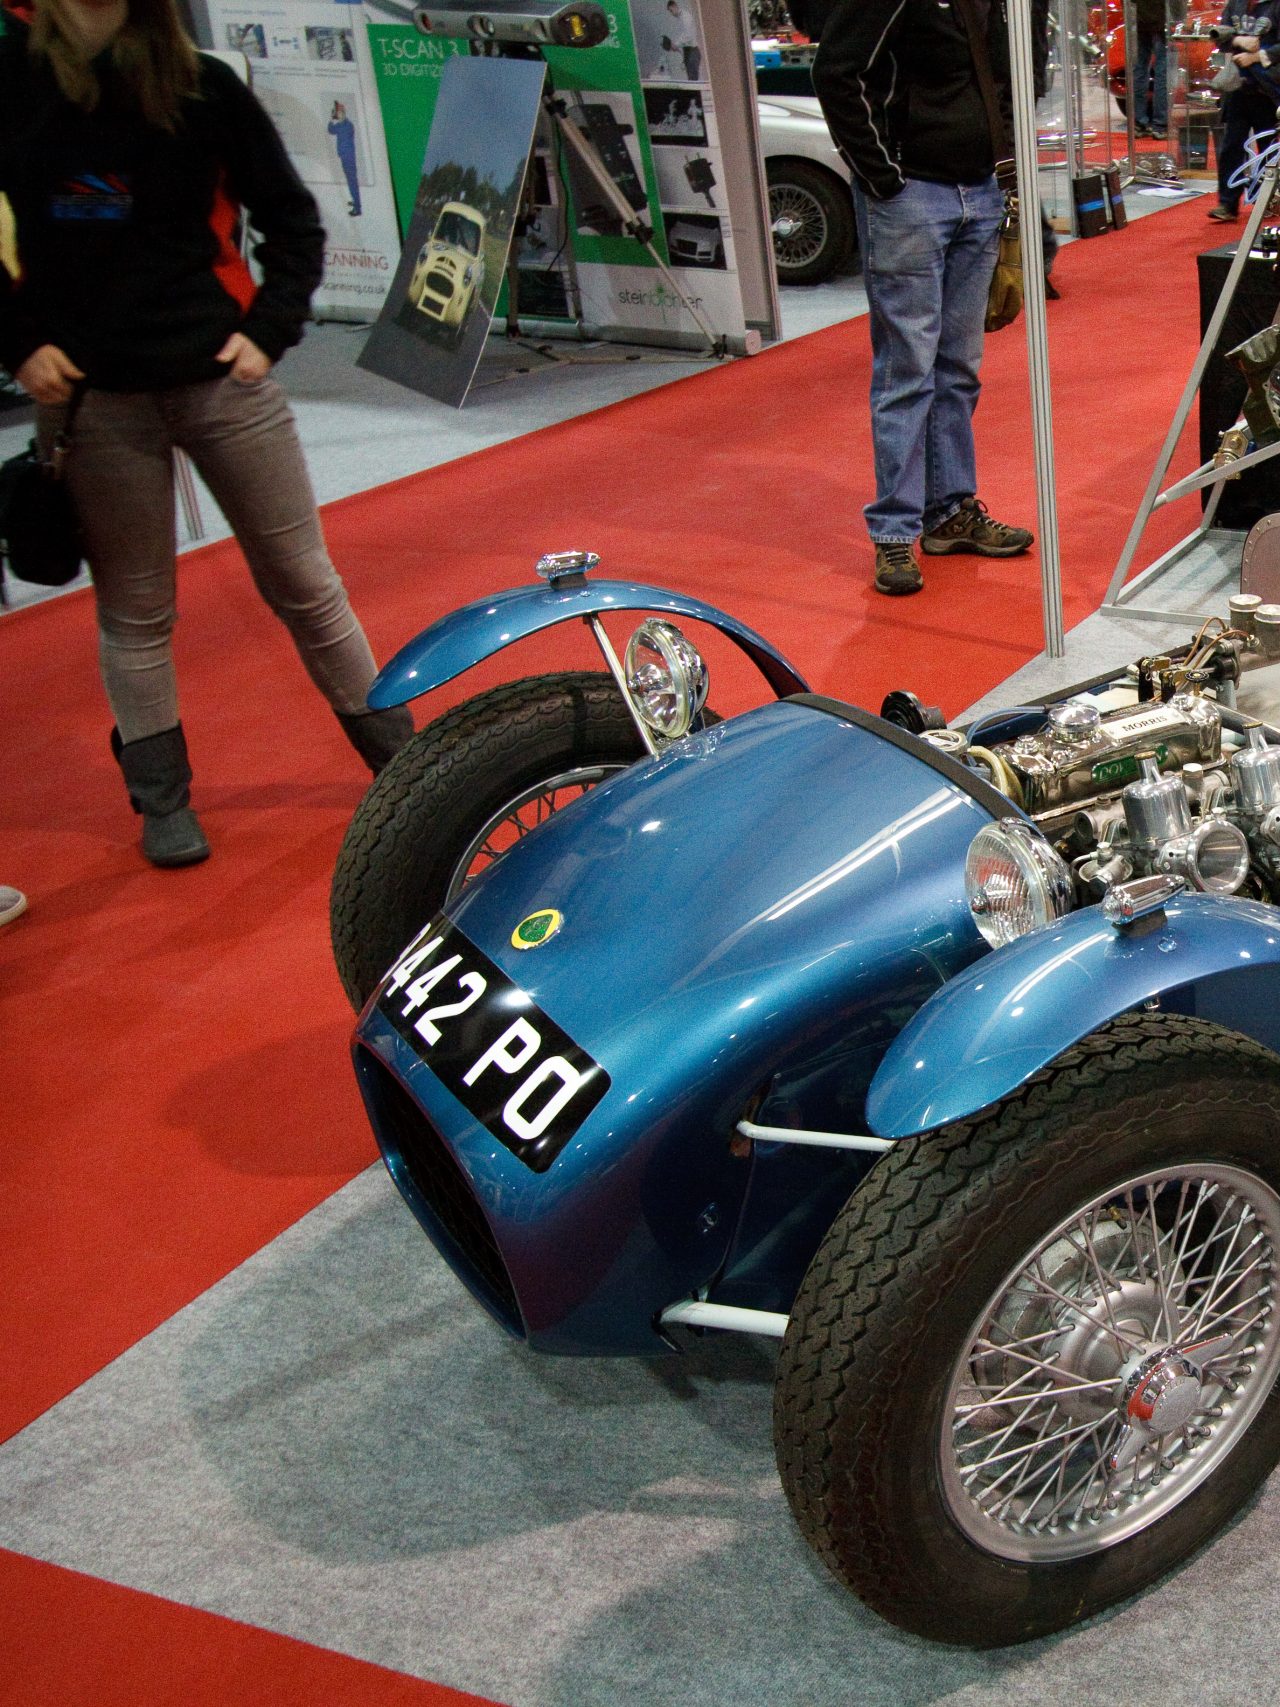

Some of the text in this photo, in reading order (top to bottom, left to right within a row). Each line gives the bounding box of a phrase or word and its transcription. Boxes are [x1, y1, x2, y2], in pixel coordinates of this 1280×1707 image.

[377, 39, 444, 59] T-SCAN
[323, 252, 389, 270] CANNING
[1121, 715, 1168, 733] MORRIS
[380, 922, 581, 1140] 442 PO
